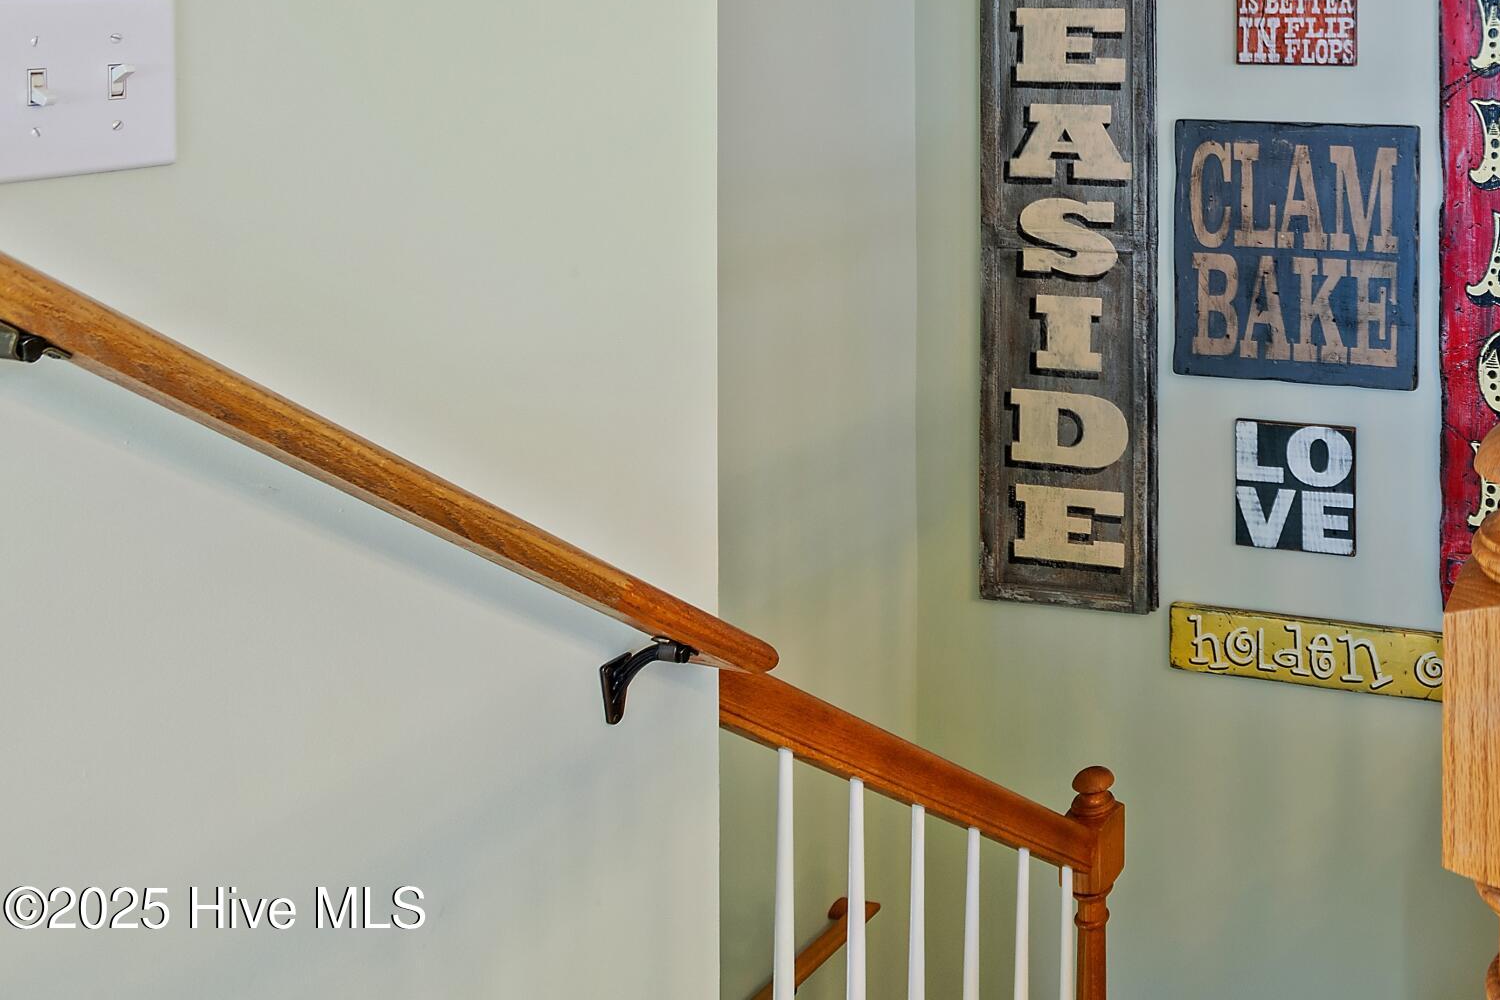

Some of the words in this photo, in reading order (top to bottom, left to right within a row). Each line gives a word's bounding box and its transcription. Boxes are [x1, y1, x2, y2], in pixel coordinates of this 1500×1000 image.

[1239, 17, 1281, 63] IN
[1284, 17, 1355, 38] FLIP
[1284, 39, 1355, 64] FLOPS
[1189, 140, 1398, 253] CLAM
[1192, 252, 1398, 367] BAKE
